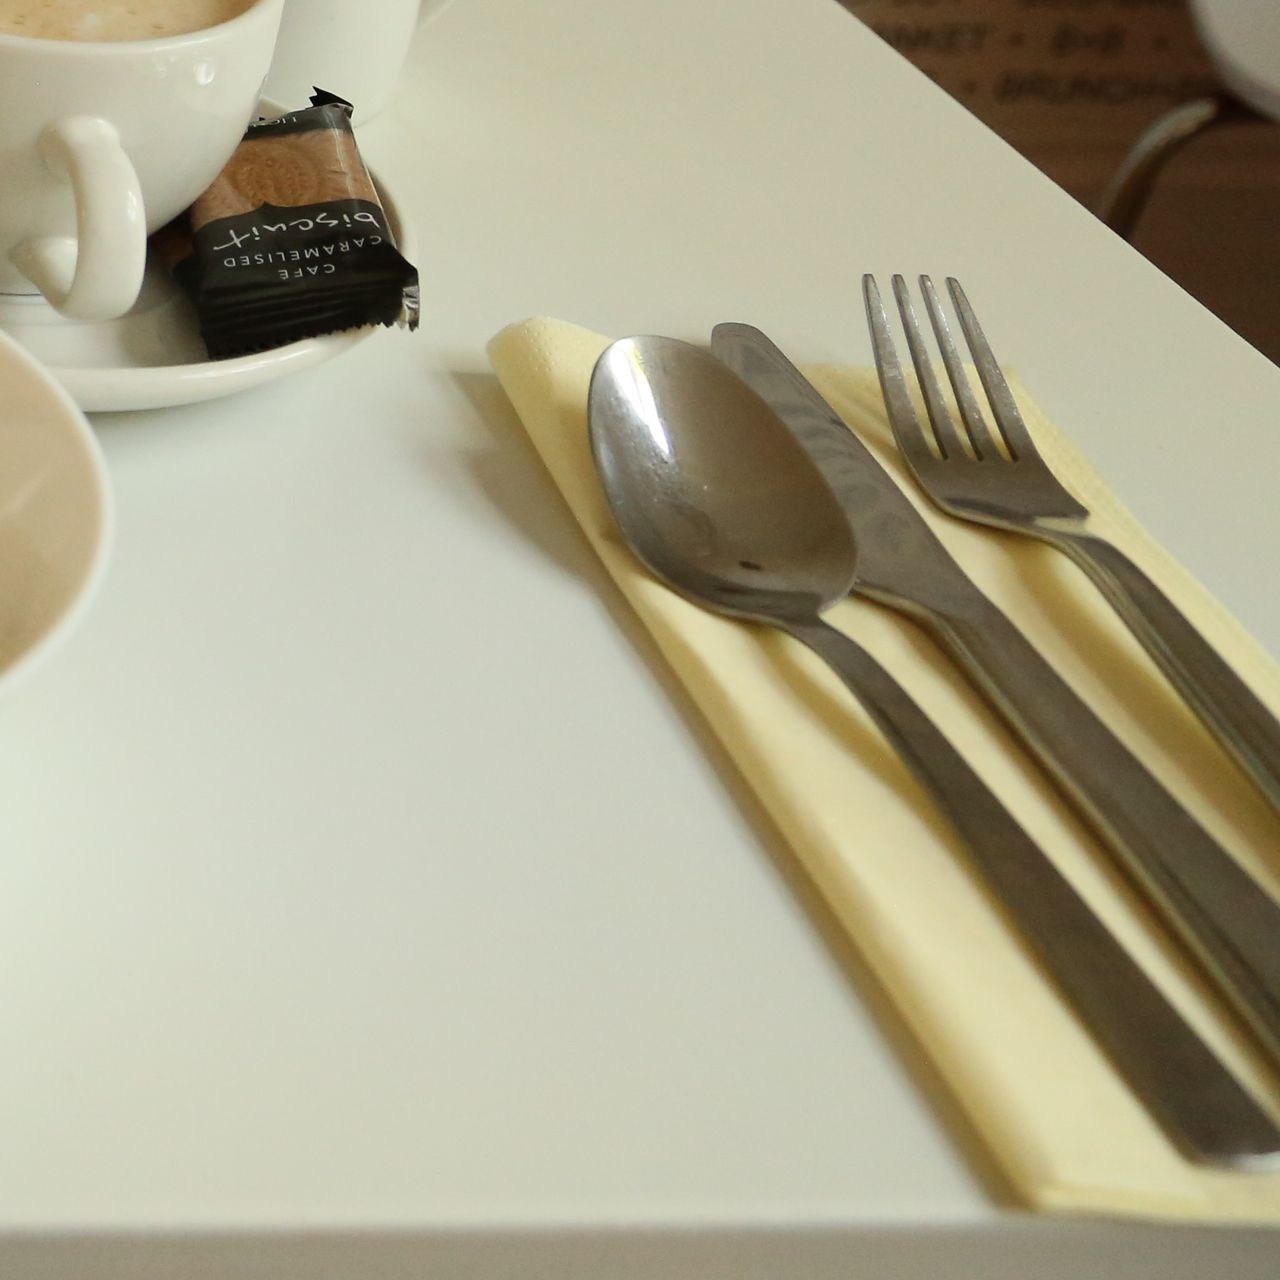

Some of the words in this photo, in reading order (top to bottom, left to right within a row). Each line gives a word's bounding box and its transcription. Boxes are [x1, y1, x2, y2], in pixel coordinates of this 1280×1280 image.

[213, 211, 381, 252] biscuit
[223, 235, 383, 268] CARAMELISED
[279, 263, 336, 281] CAFE
